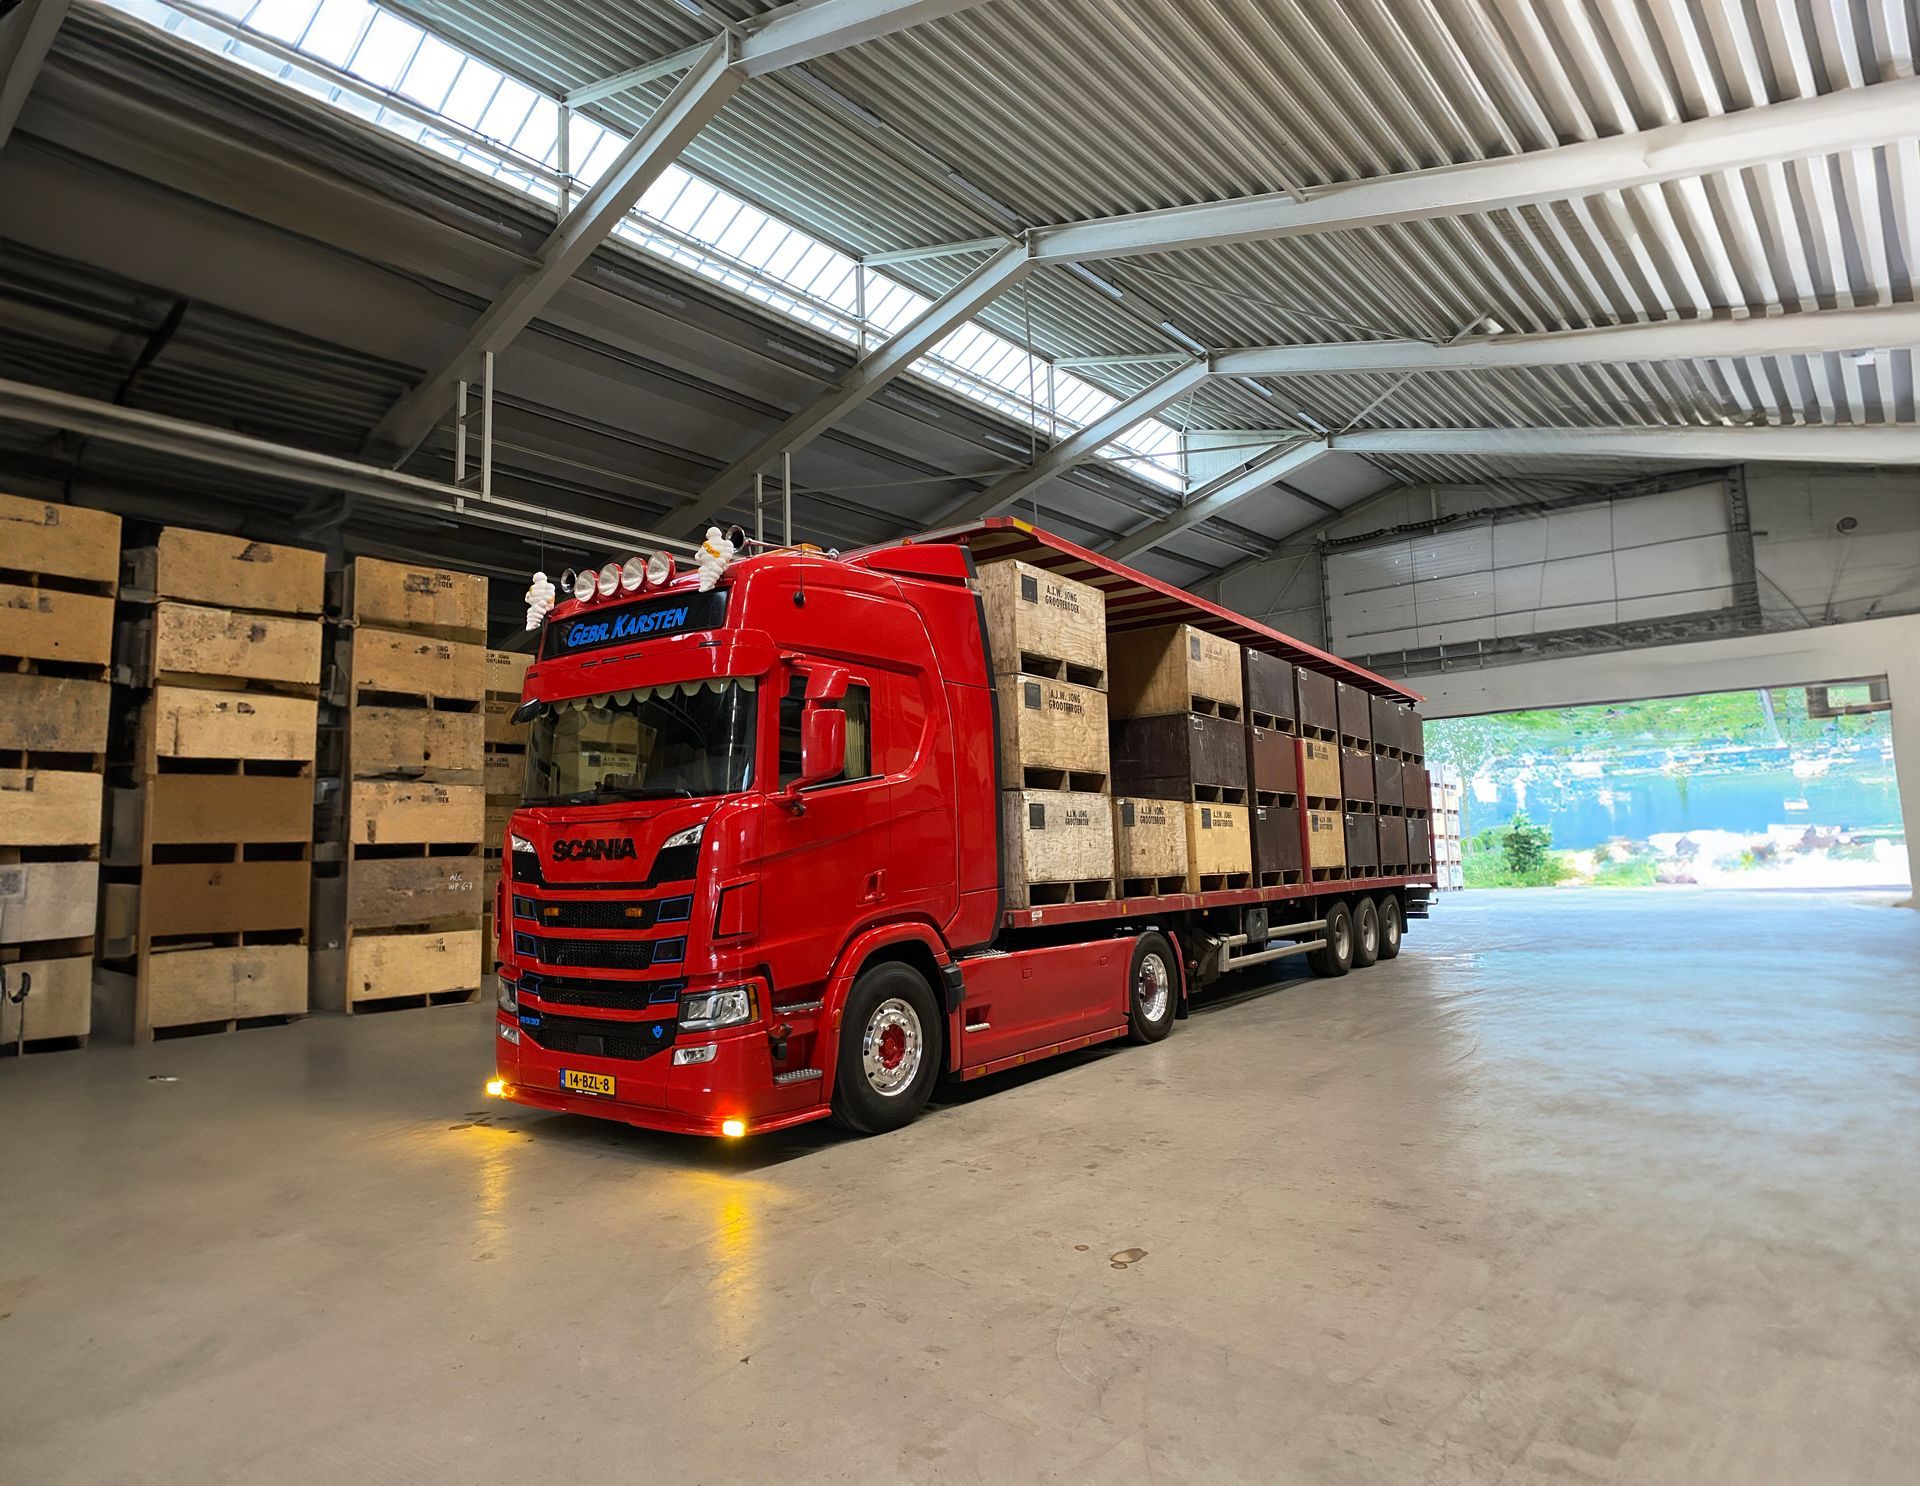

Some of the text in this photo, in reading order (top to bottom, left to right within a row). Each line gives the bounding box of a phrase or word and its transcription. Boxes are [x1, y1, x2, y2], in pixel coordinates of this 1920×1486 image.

[1045, 594, 1080, 614] GROOTEBROEK
[1064, 590, 1078, 603] JONG
[568, 606, 688, 647] GEBR. KARSTEN
[1048, 699, 1084, 714] GROOTEBROEK
[1068, 692, 1081, 704] JONG
[552, 838, 638, 861] SCANIA
[570, 1072, 610, 1092] 14-BZL-8
